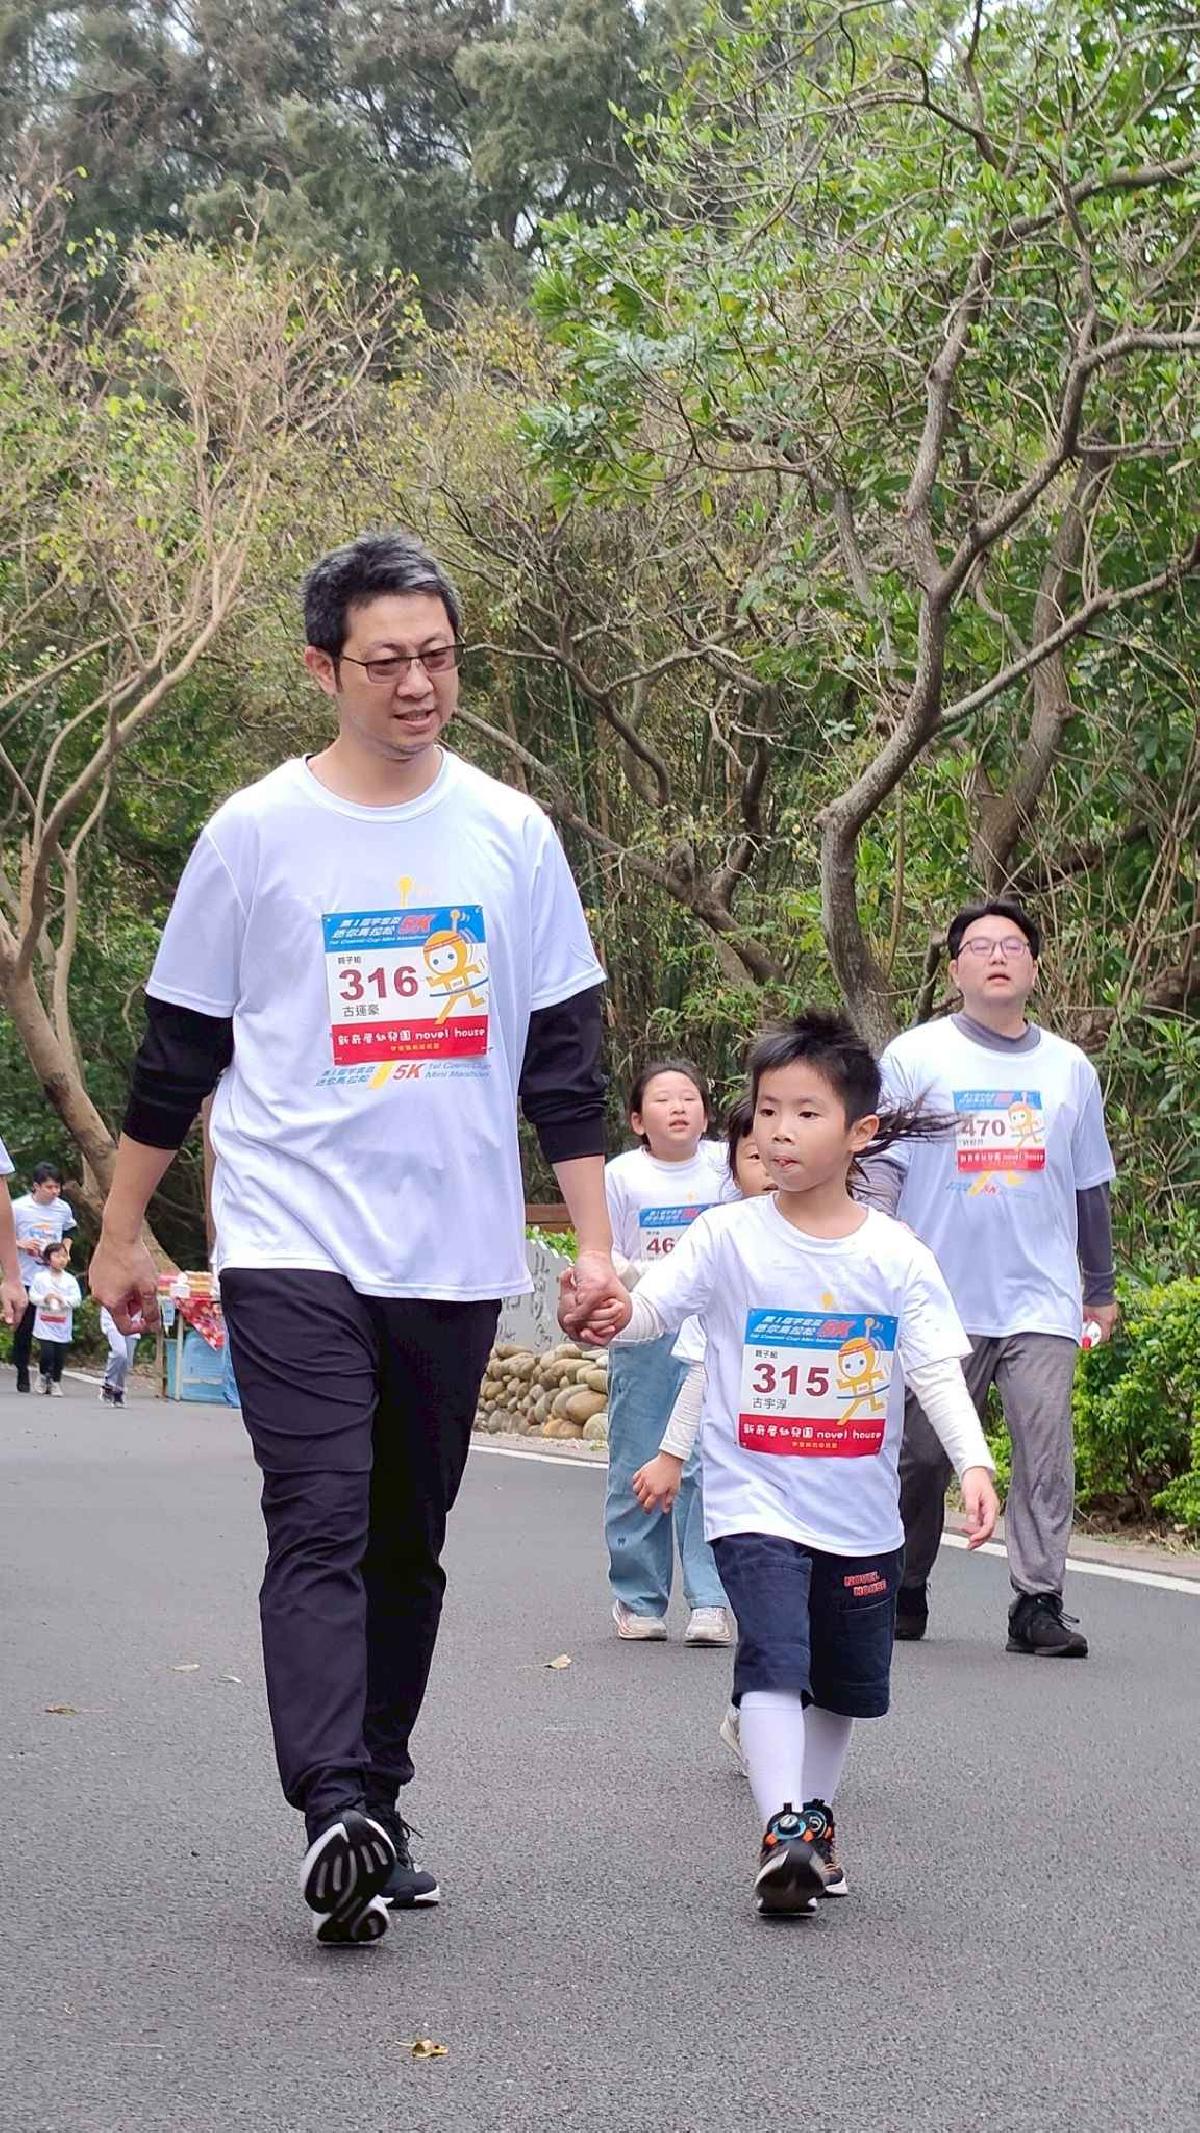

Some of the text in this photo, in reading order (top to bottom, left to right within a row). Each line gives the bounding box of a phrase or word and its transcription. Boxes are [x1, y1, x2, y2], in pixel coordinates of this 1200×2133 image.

[339, 965, 418, 1001] 316
[415, 1029, 449, 1041] novel
[454, 1027, 485, 1038] house
[393, 1063, 425, 1081] 5K
[961, 1119, 1006, 1137] 470
[753, 1363, 829, 1397] 315
[816, 1429, 847, 1440] novel
[852, 1429, 881, 1440] house
